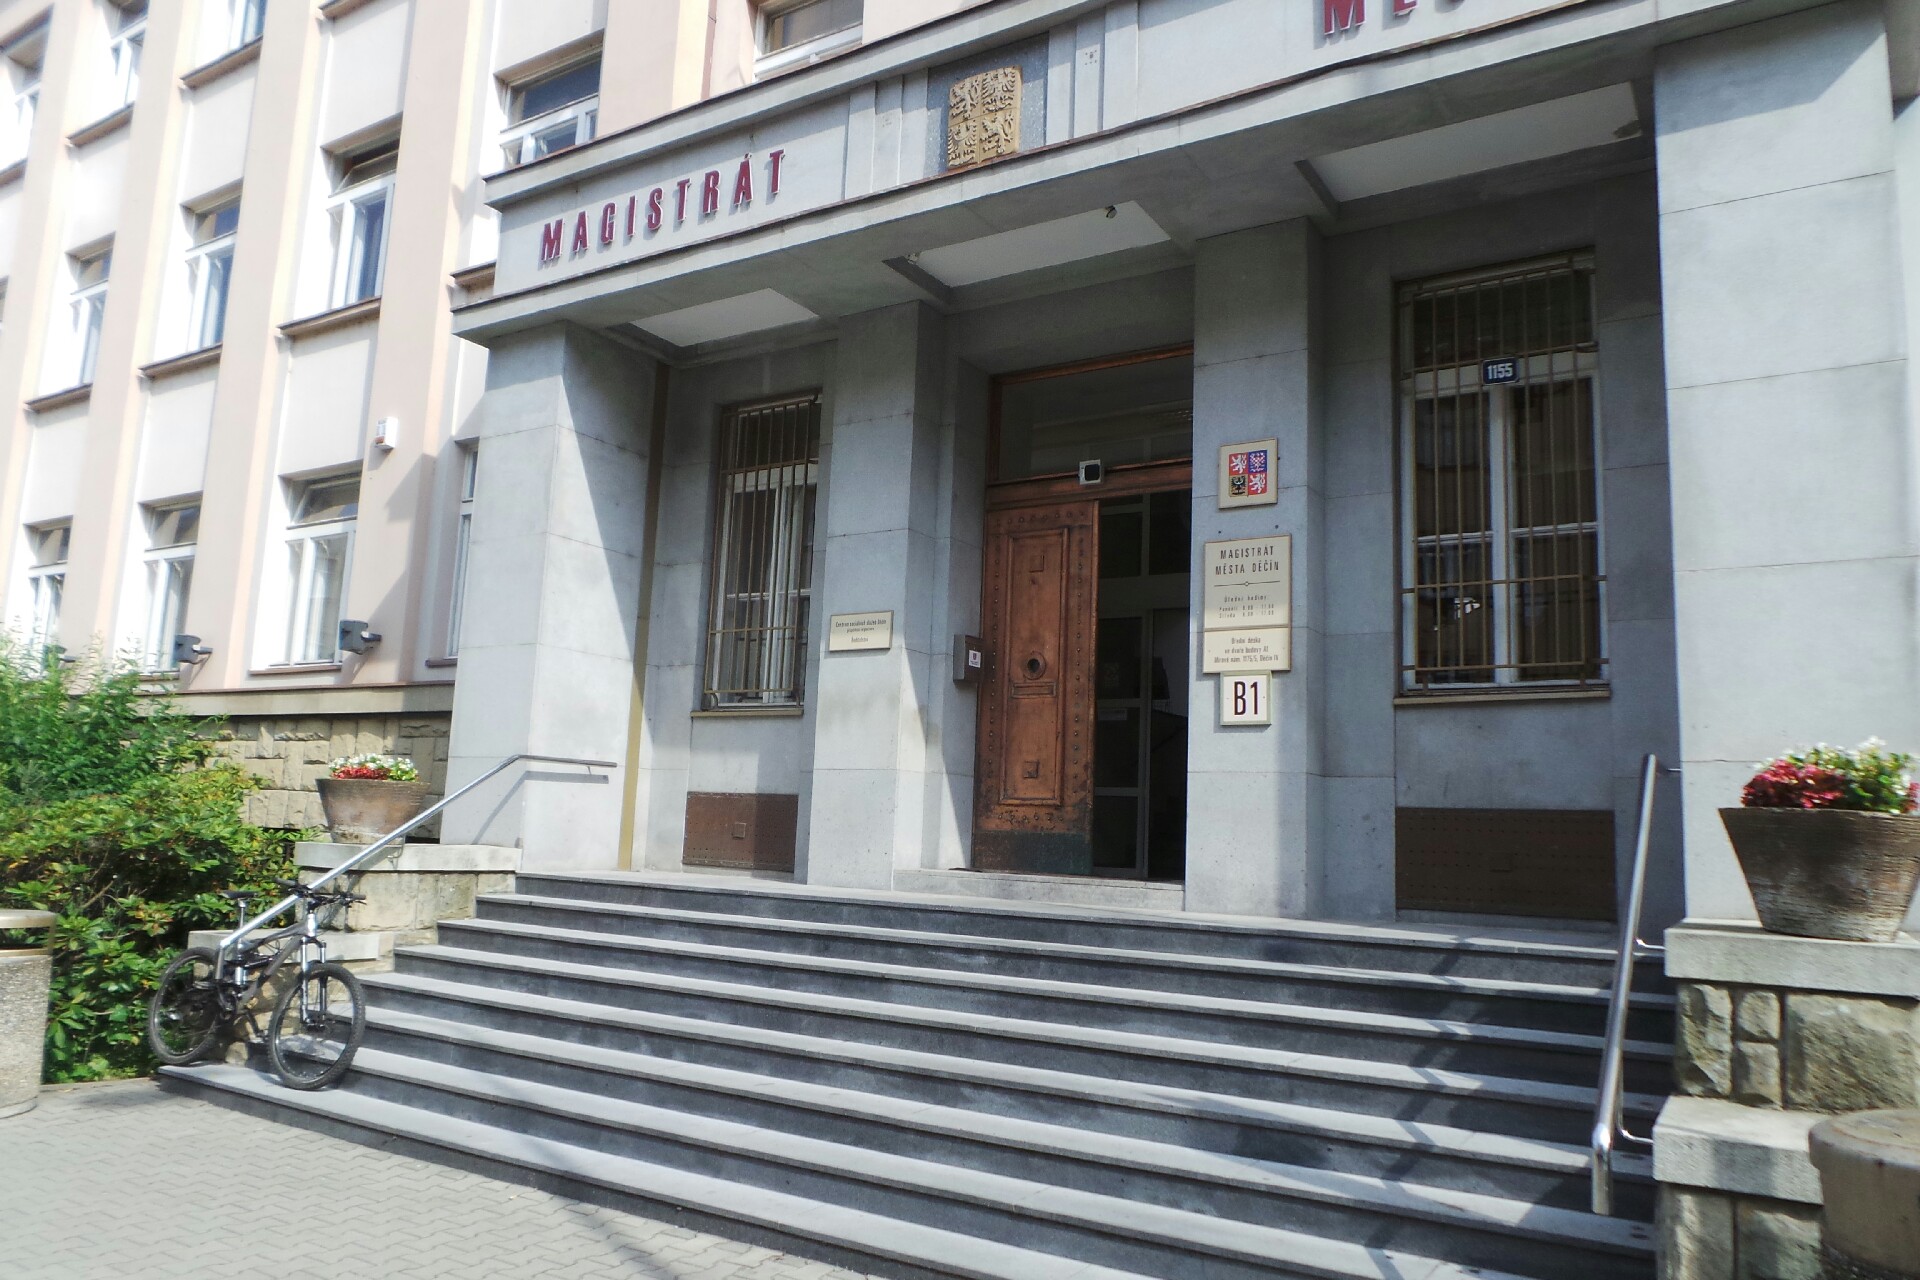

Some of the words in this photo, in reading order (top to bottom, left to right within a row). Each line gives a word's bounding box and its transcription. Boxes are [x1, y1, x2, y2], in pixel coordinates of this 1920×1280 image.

[541, 149, 785, 262] MAGISTRÁT
[1487, 362, 1513, 379] 1155
[1234, 681, 1258, 715] B1
